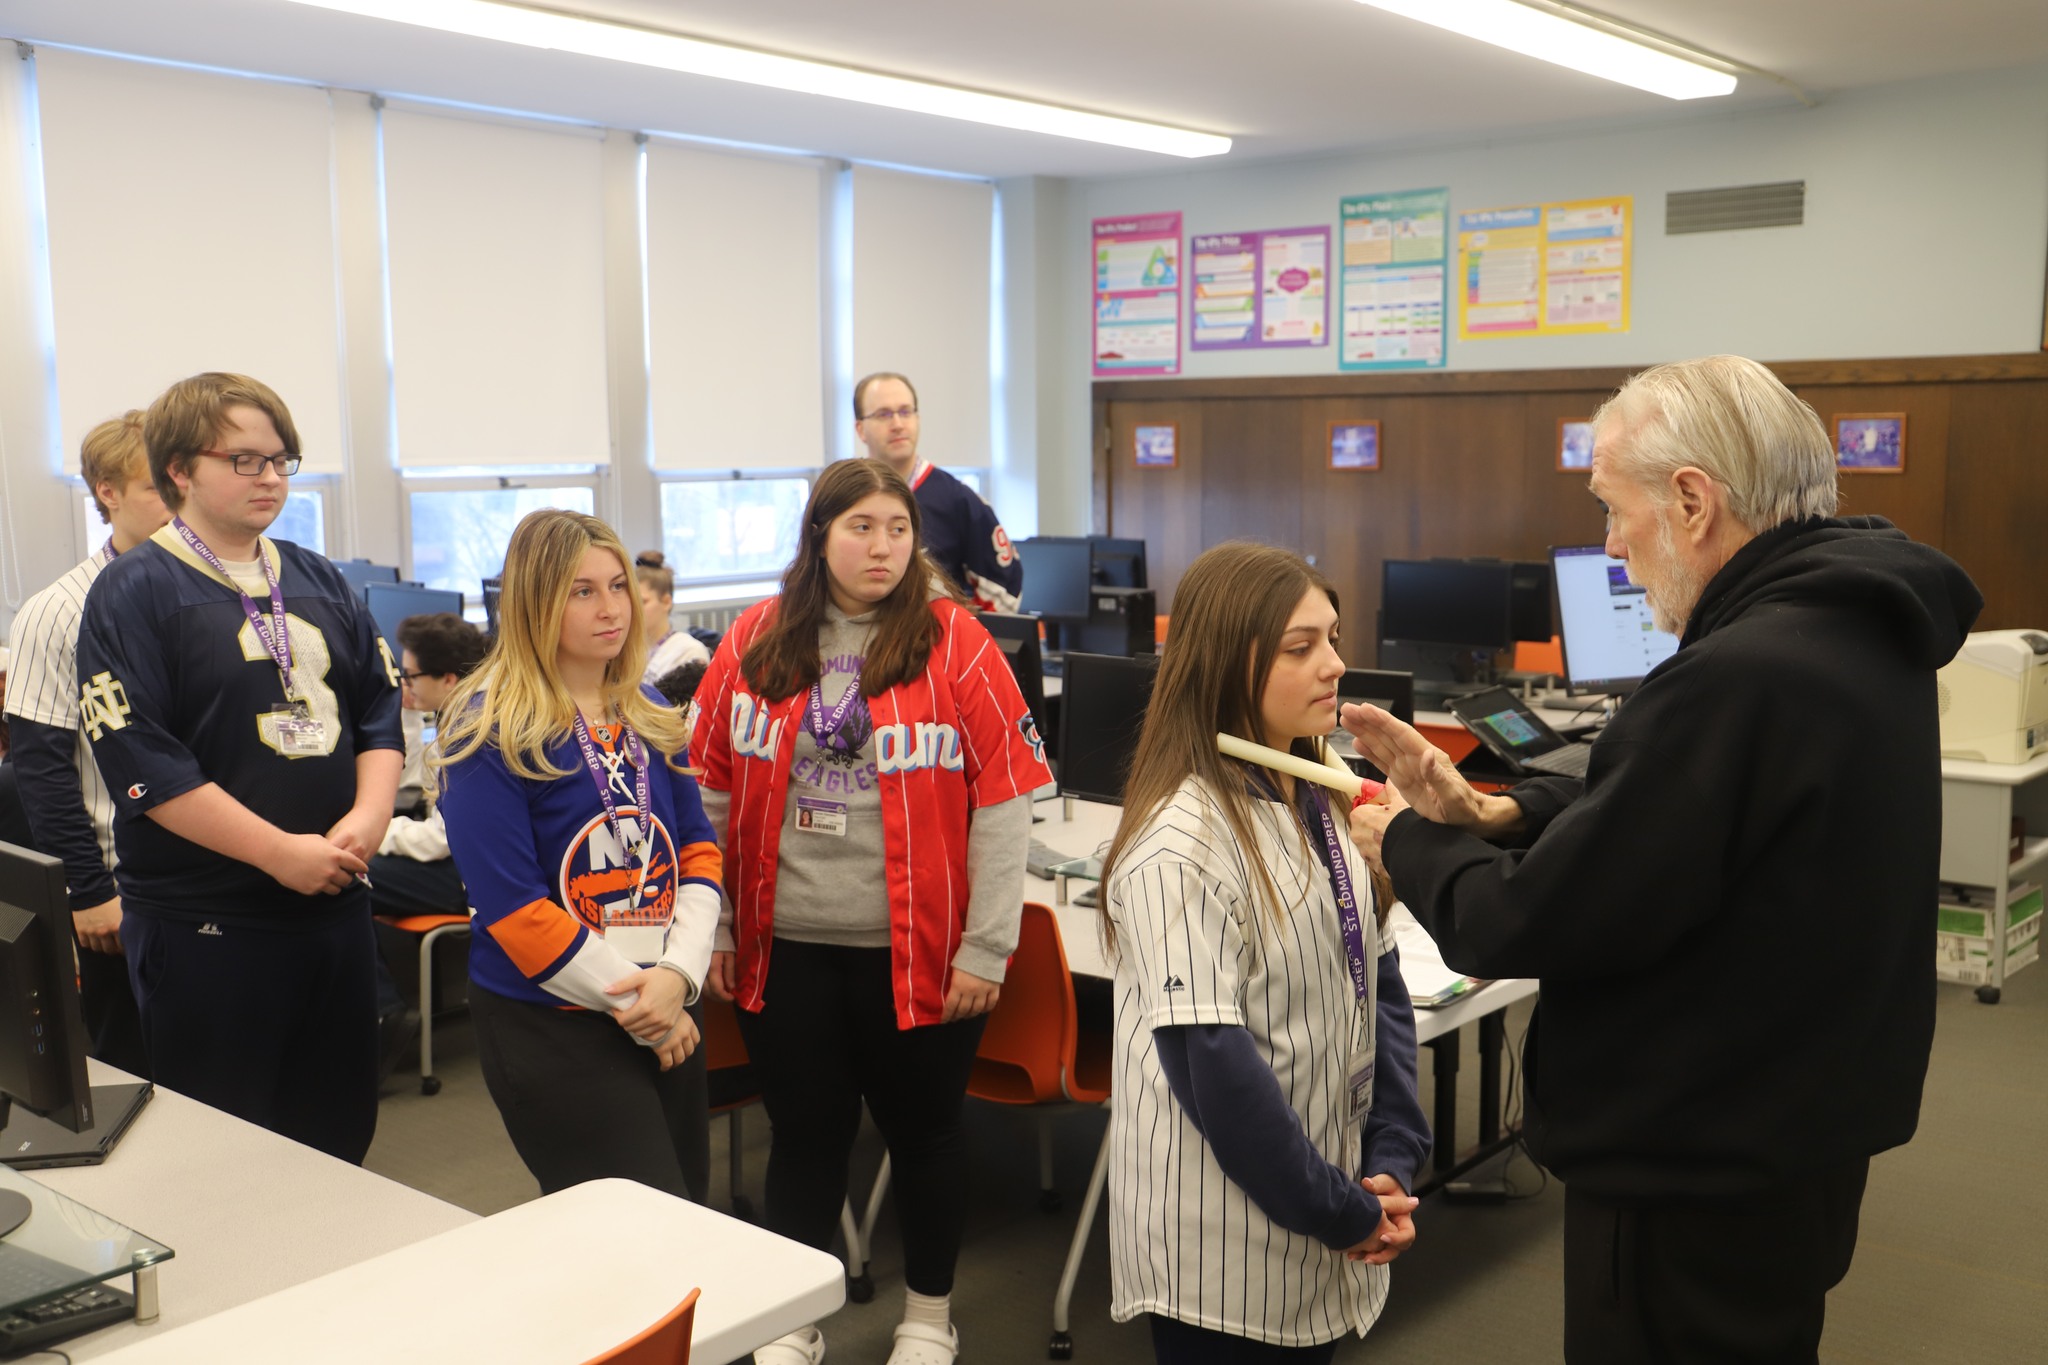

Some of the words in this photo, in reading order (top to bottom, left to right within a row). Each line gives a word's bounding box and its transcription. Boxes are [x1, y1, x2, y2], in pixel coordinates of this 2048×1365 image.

[178, 526, 198, 545] PREP
[250, 610, 264, 626] ST.
[272, 601, 282, 613] ST.
[274, 614, 287, 654] EDMUND
[238, 612, 342, 759] 3
[824, 720, 838, 733] ST.
[831, 681, 860, 719] EDMUND
[583, 744, 600, 770] PREP
[636, 765, 645, 780] ST.
[794, 756, 879, 794] EAGLES
[601, 788, 612, 805] ST.
[636, 783, 648, 830] EDMUND
[1322, 812, 1338, 846] PREP
[1330, 848, 1354, 910] EDMUND
[1346, 912, 1359, 932] ST.
